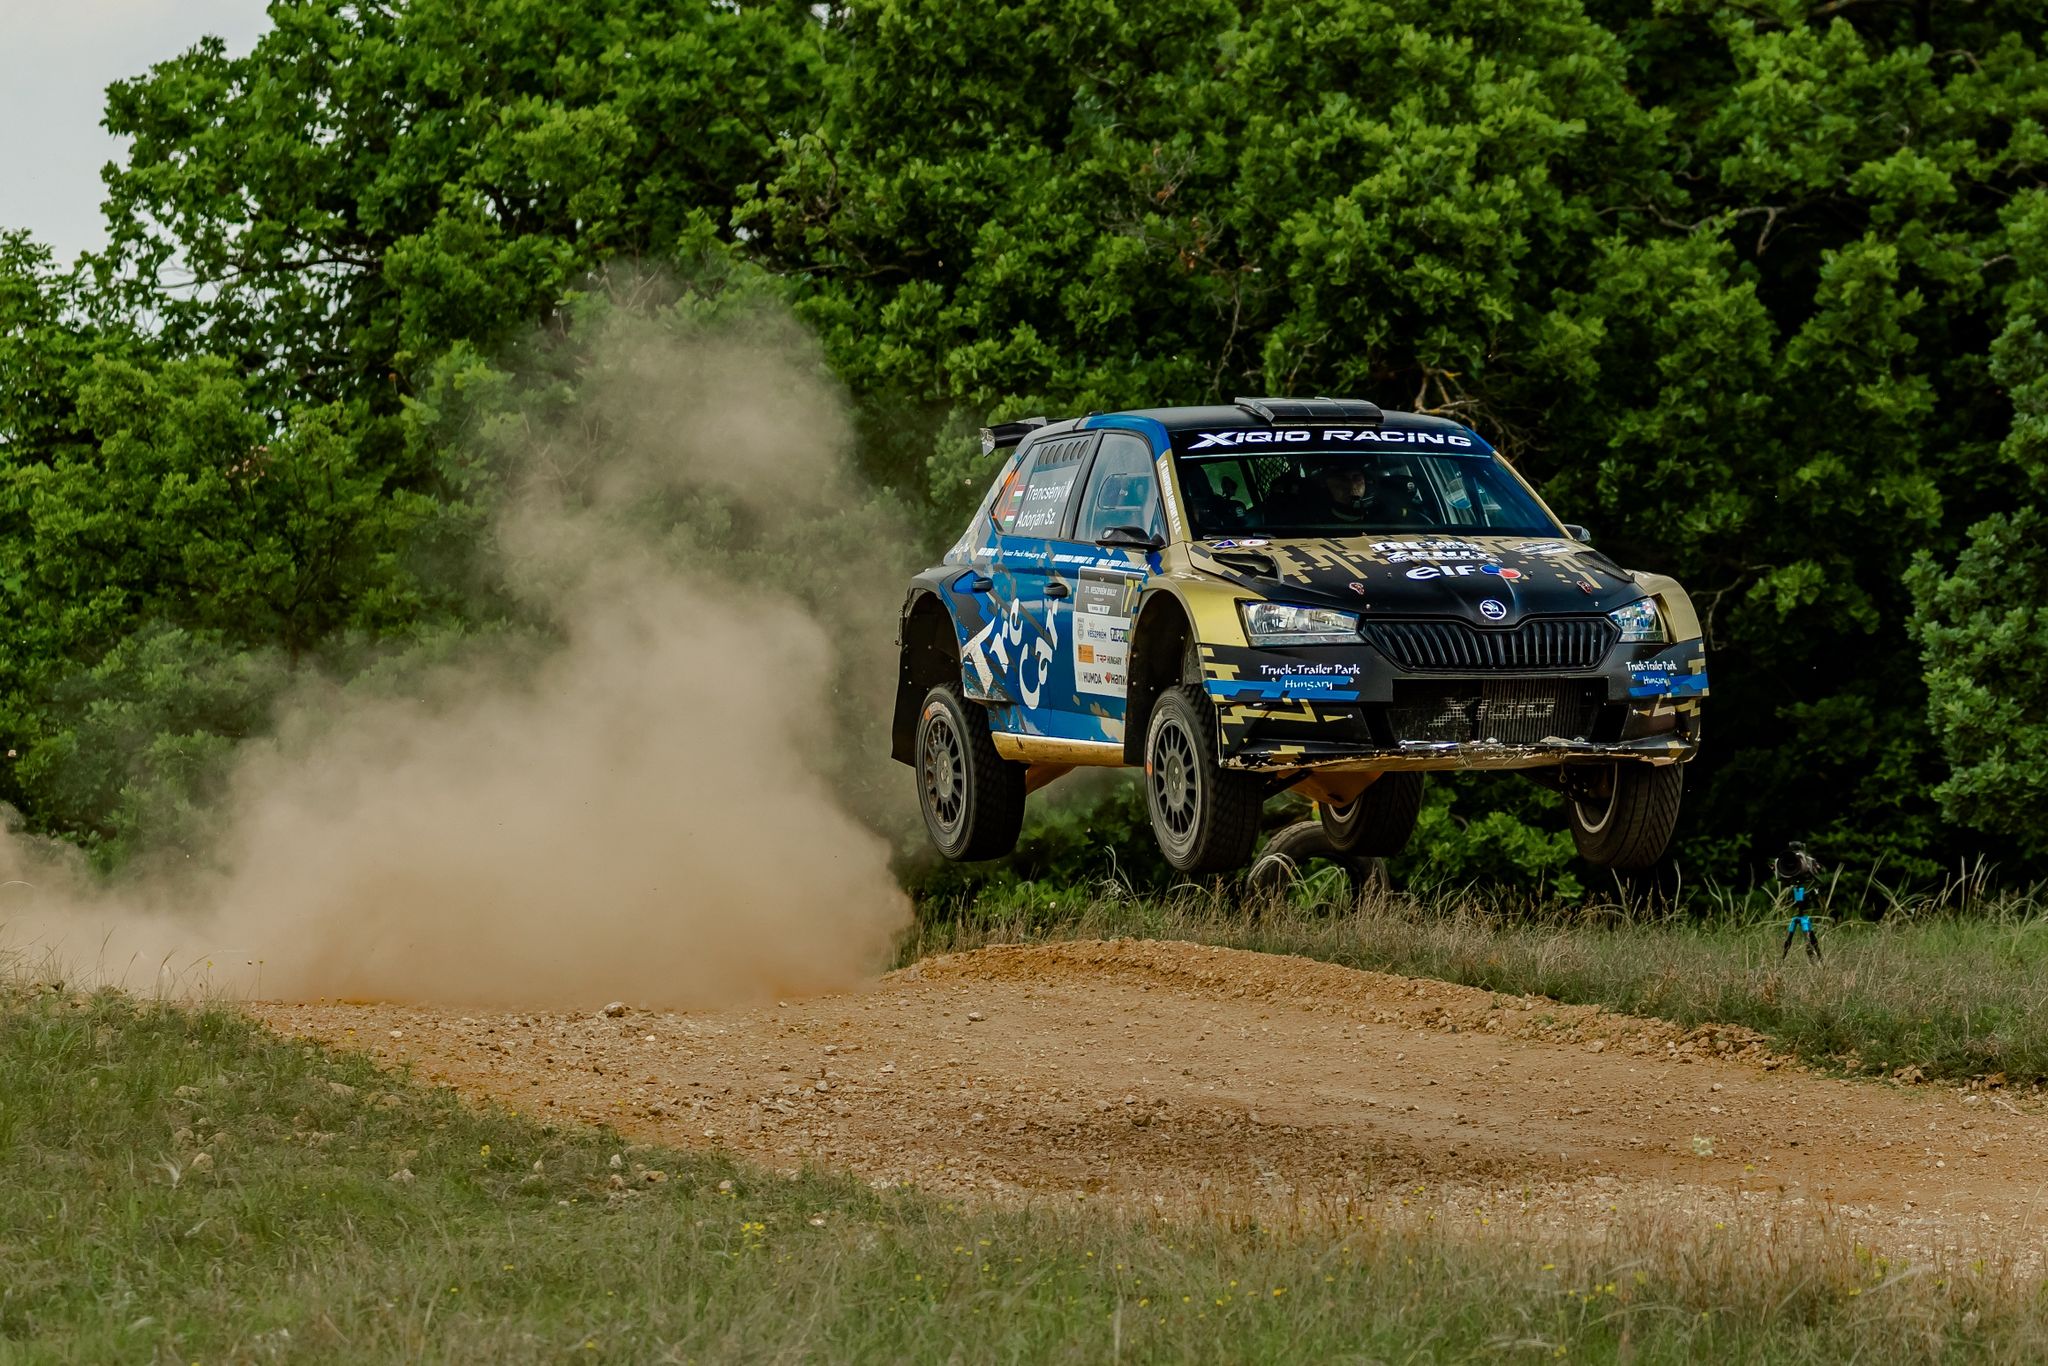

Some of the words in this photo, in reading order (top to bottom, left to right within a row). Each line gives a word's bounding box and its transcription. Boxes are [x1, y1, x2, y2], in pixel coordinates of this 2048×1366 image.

[1187, 430, 1311, 450] XIQIO
[1323, 430, 1472, 447] RACING
[1026, 482, 1067, 502] Trencsényi
[1015, 510, 1045, 530] Adorján
[1124, 580, 1134, 612] 7
[1087, 630, 1106, 638] VESZPRÉM
[961, 598, 1023, 697] Tre
[1019, 598, 1058, 710] Car
[1260, 664, 1332, 675] Truck-Trailer
[1334, 664, 1361, 675] Park
[1662, 660, 1677, 670] Park
[1083, 672, 1102, 684] HUMDA
[1284, 680, 1333, 691] Hungary
